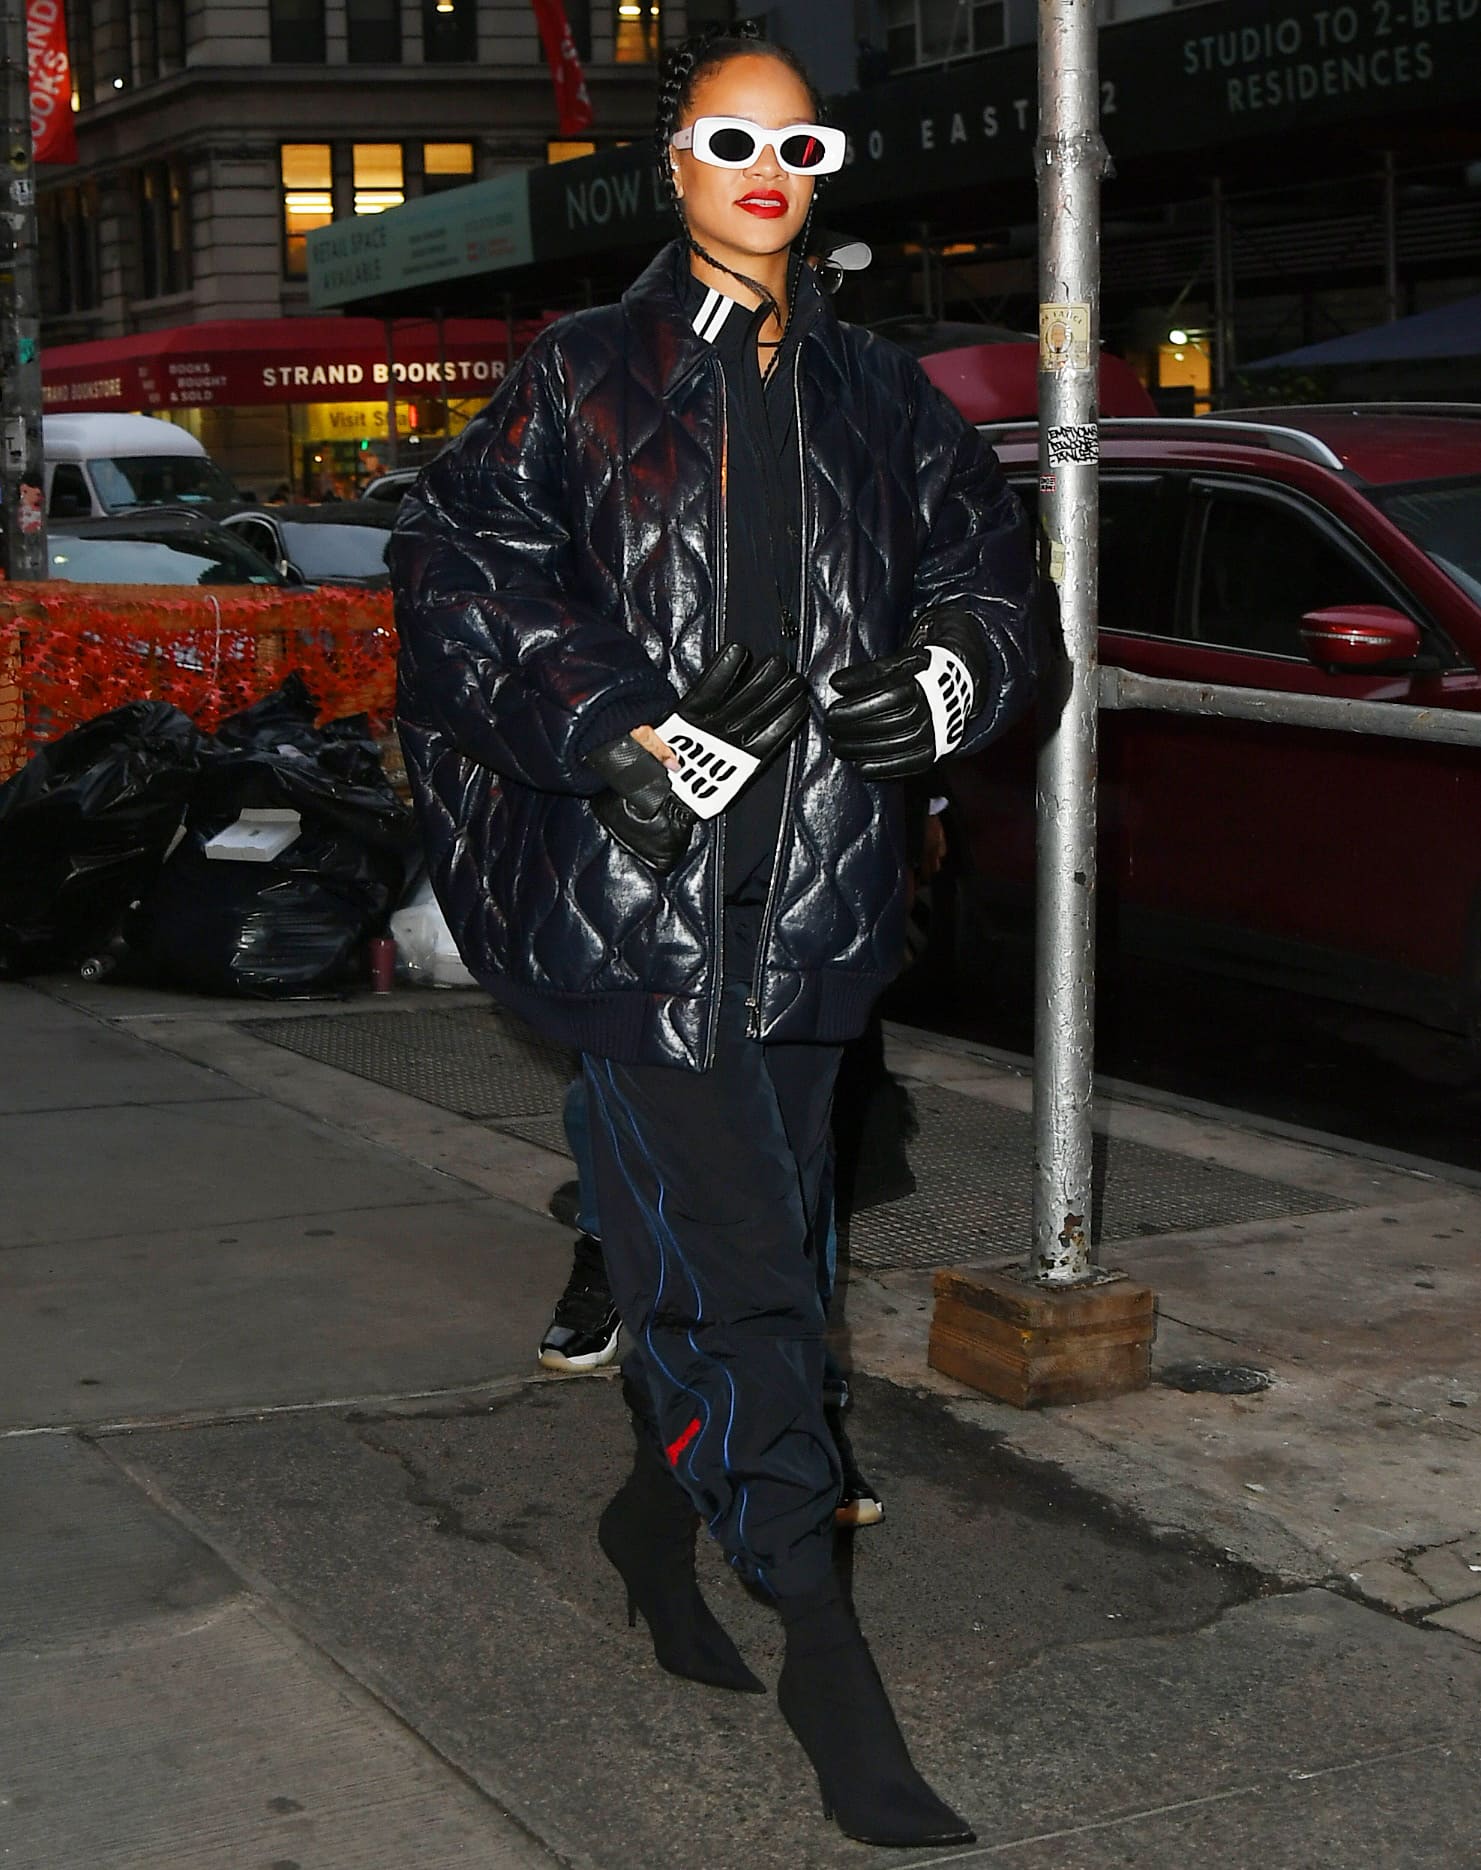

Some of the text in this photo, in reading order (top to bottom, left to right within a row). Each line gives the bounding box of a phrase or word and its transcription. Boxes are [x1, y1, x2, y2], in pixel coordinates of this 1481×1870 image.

[27, 0, 59, 77] AND
[1183, 18, 1301, 75] STUDIO
[1313, 6, 1359, 48] TO
[29, 49, 69, 156] OOKS
[1226, 42, 1434, 112] RESIDENCES
[920, 100, 1030, 150] EAST
[1099, 81, 1118, 115] 2
[565, 169, 641, 230] NOW
[42, 384, 69, 402] TRAND
[262, 360, 506, 388] STRAND BOOKSTOR
[329, 411, 367, 428] Visit
